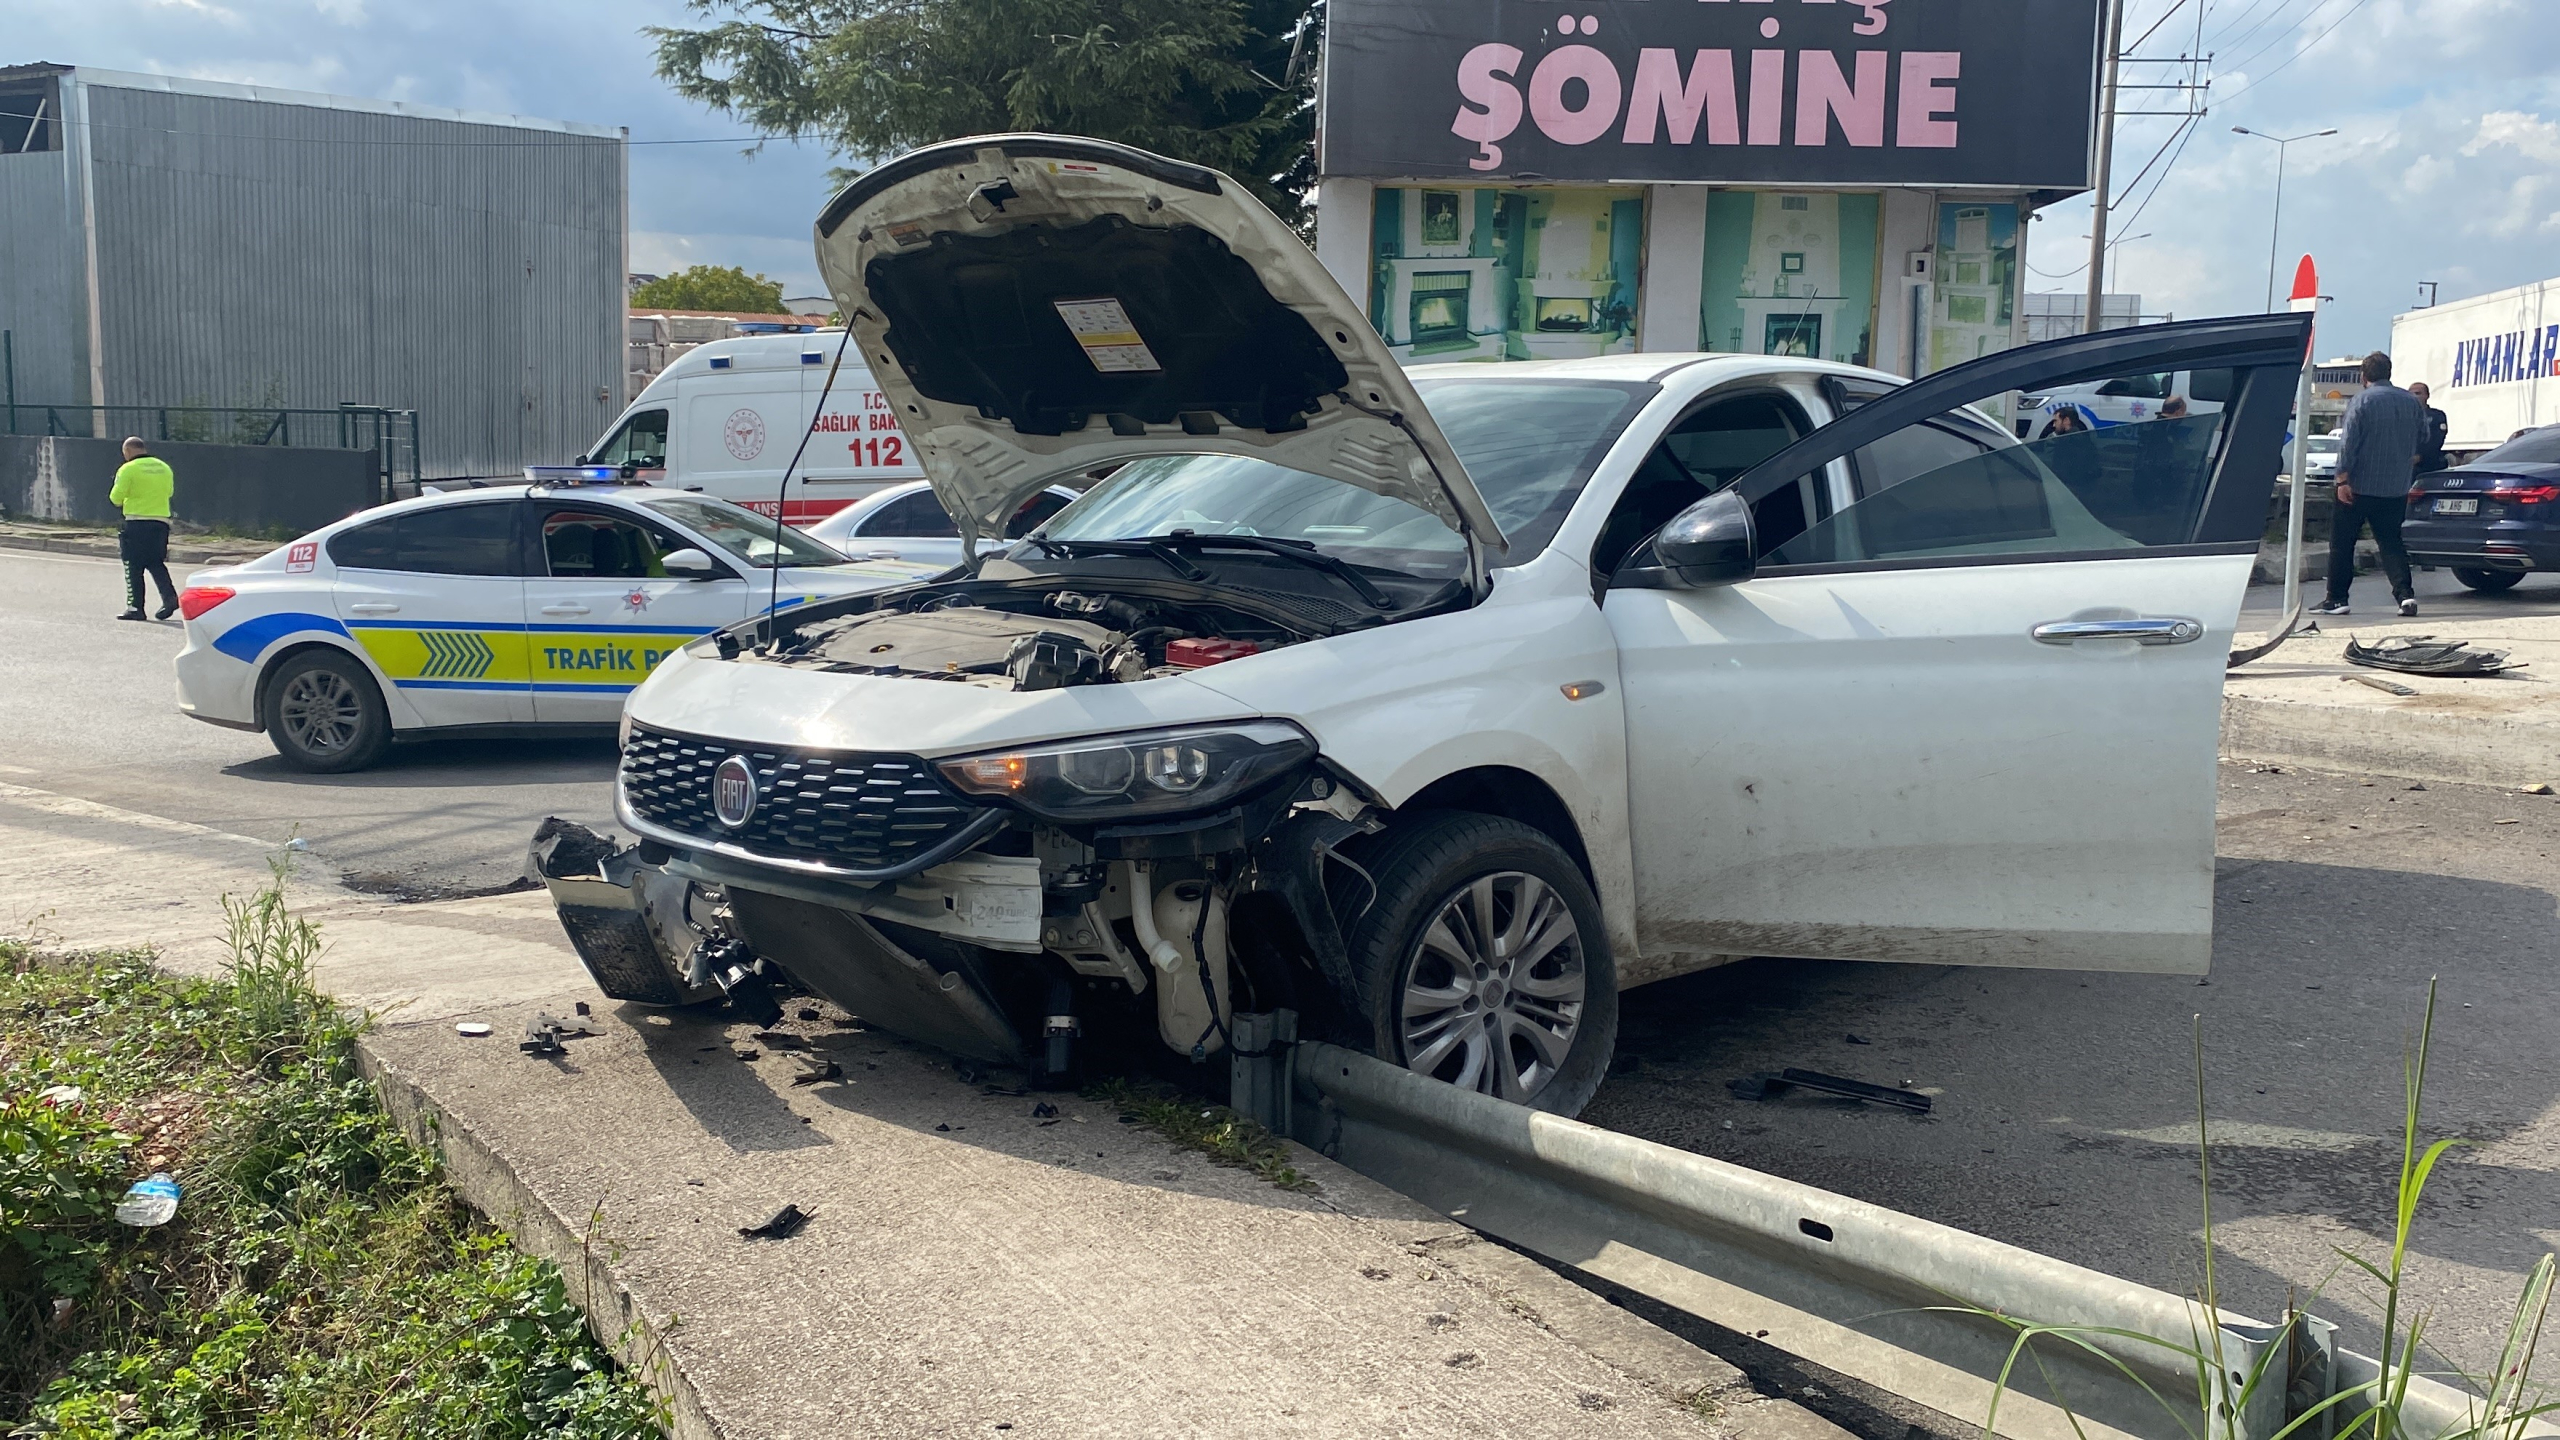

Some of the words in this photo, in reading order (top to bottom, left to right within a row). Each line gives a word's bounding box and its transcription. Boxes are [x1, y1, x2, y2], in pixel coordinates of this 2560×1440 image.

[1451, 14, 1960, 171] ŞÖMİNE
[2451, 324, 2559, 388] AYMANLAR
[863, 392, 887, 410] T.C.
[869, 413, 900, 431] BAK
[848, 436, 903, 467] 112
[292, 545, 313, 561] 112
[544, 643, 636, 671] TRAFİK
[722, 778, 746, 811] FIAT
